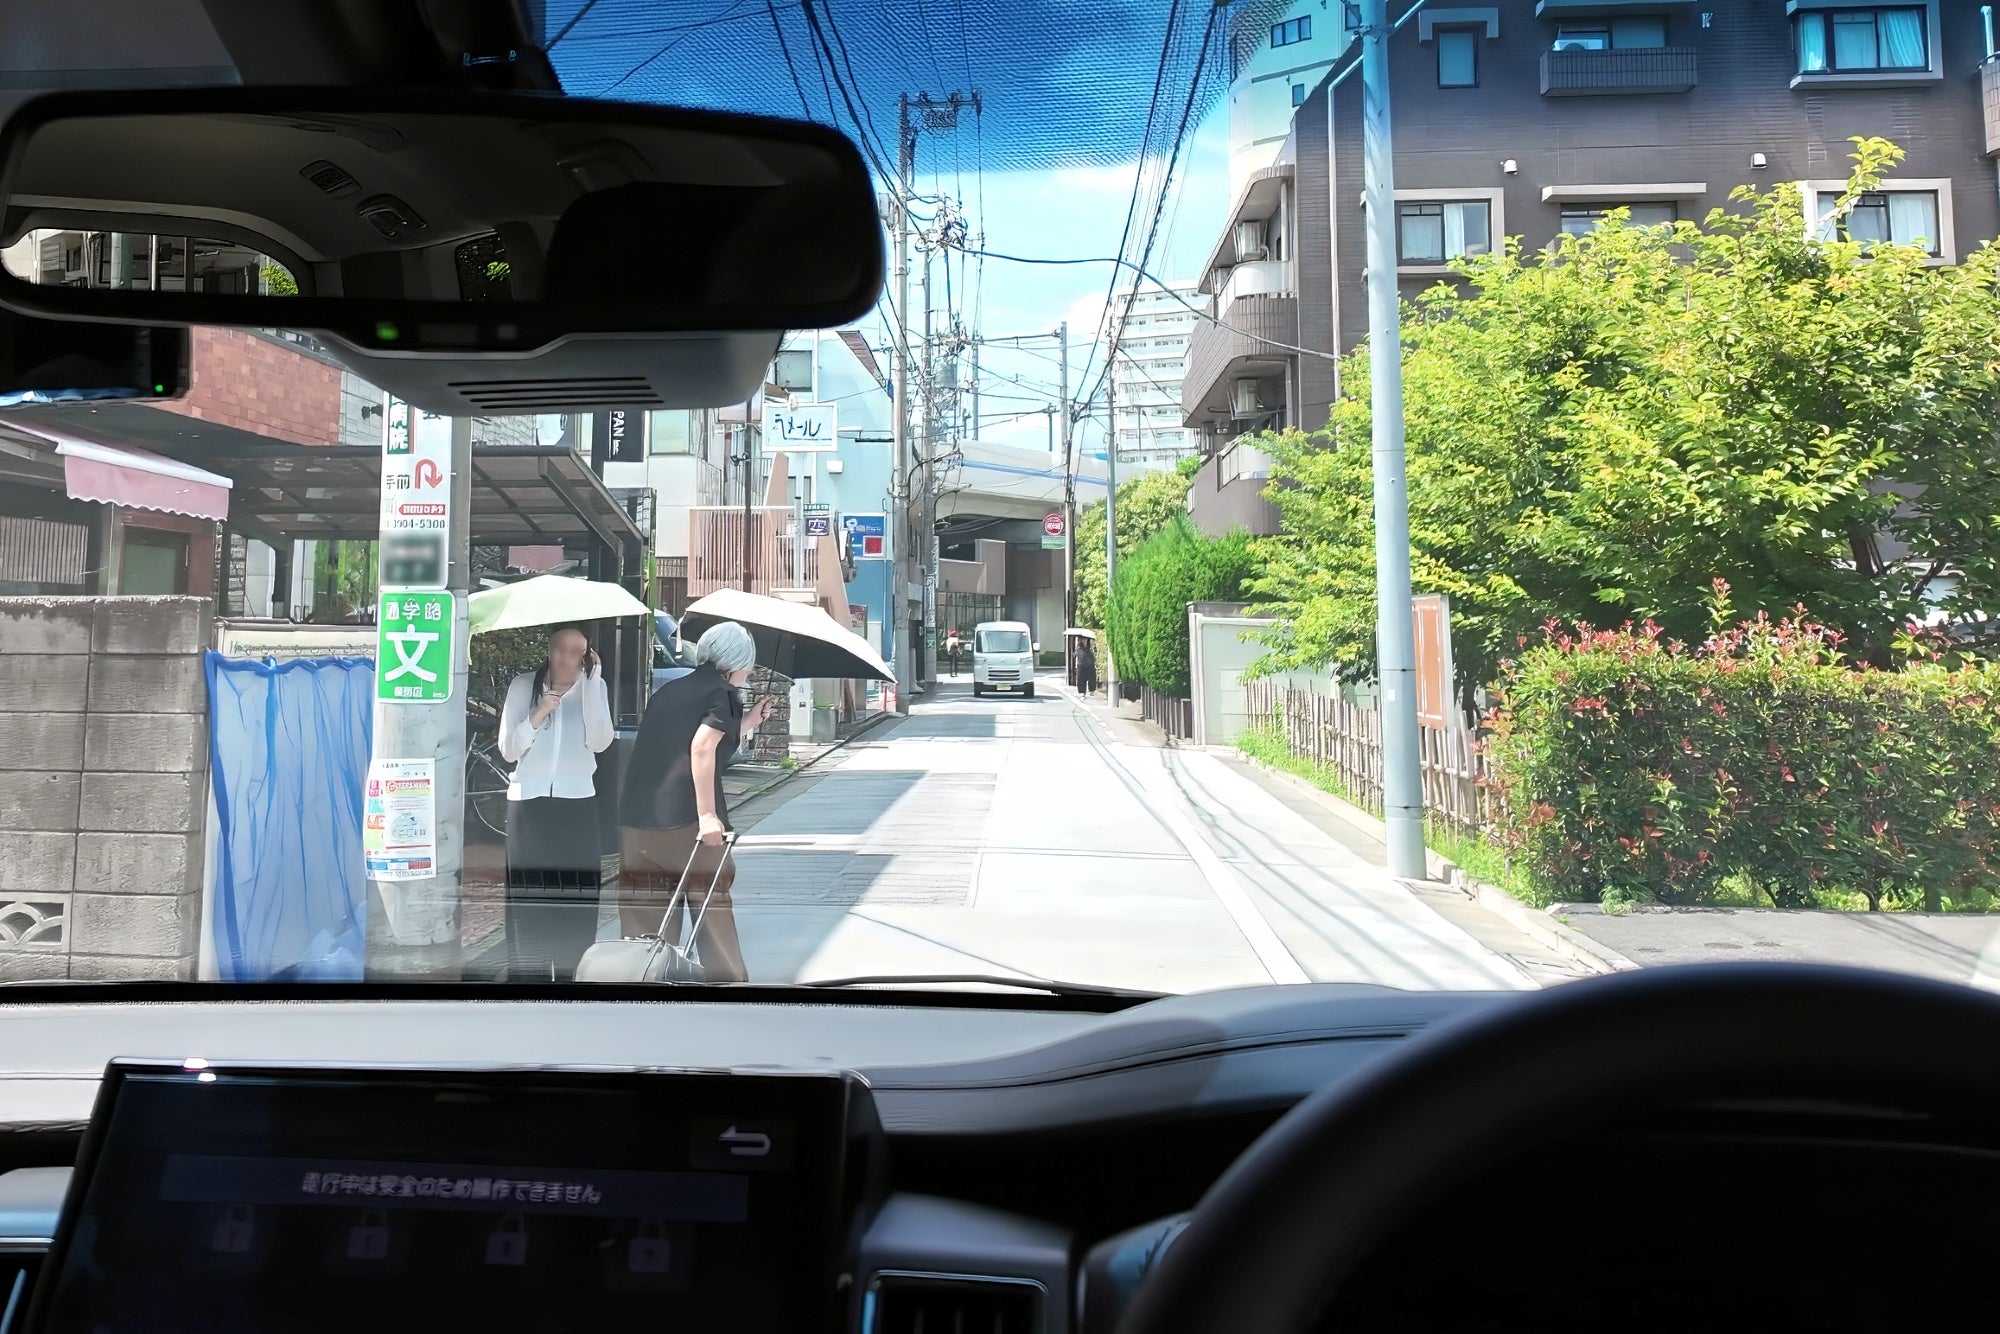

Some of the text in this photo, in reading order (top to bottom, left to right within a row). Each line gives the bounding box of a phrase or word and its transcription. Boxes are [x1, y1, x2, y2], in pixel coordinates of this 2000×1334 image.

[772, 413, 832, 441] ラメール
[384, 623, 440, 682] 文
